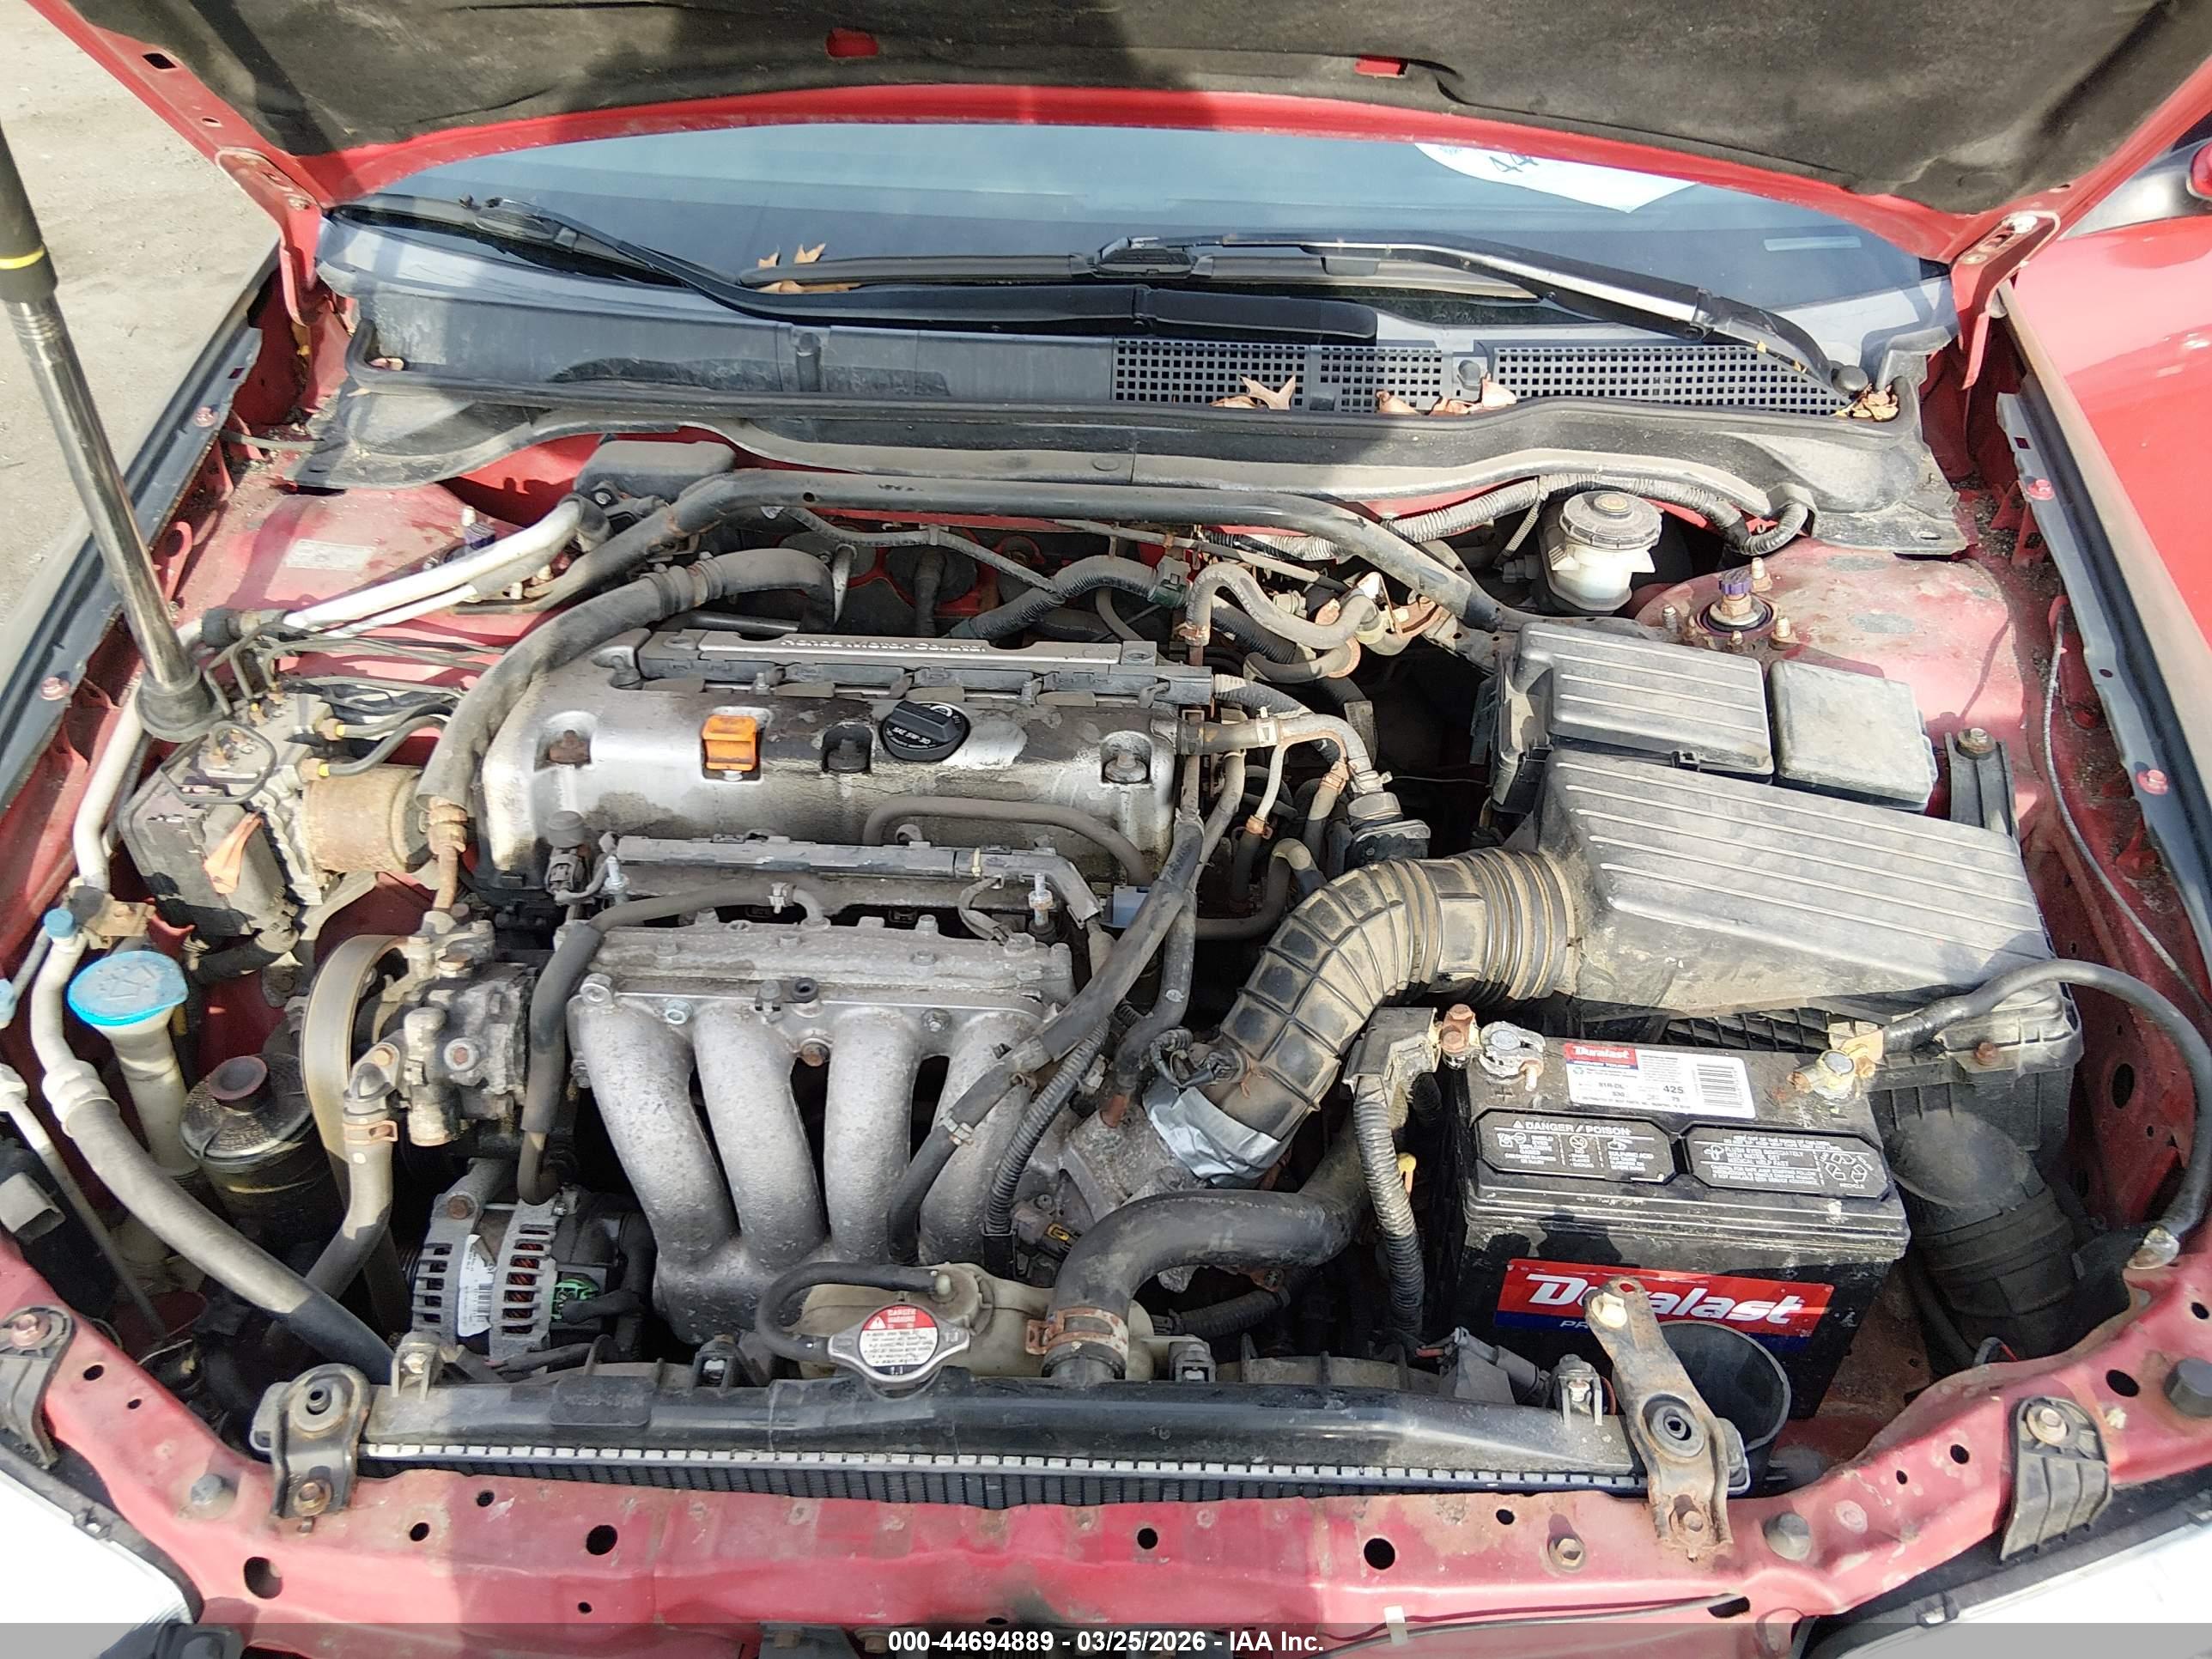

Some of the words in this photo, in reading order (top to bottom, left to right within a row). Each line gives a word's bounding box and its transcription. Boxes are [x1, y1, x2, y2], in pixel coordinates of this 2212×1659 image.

[1573, 1045, 1630, 1059] Duralast
[1663, 1085, 1684, 1094] 425
[1525, 1121, 1574, 1133] DANGER
[1586, 1125, 1632, 1135] POISON
[1526, 1273, 1806, 1324] Dalast
